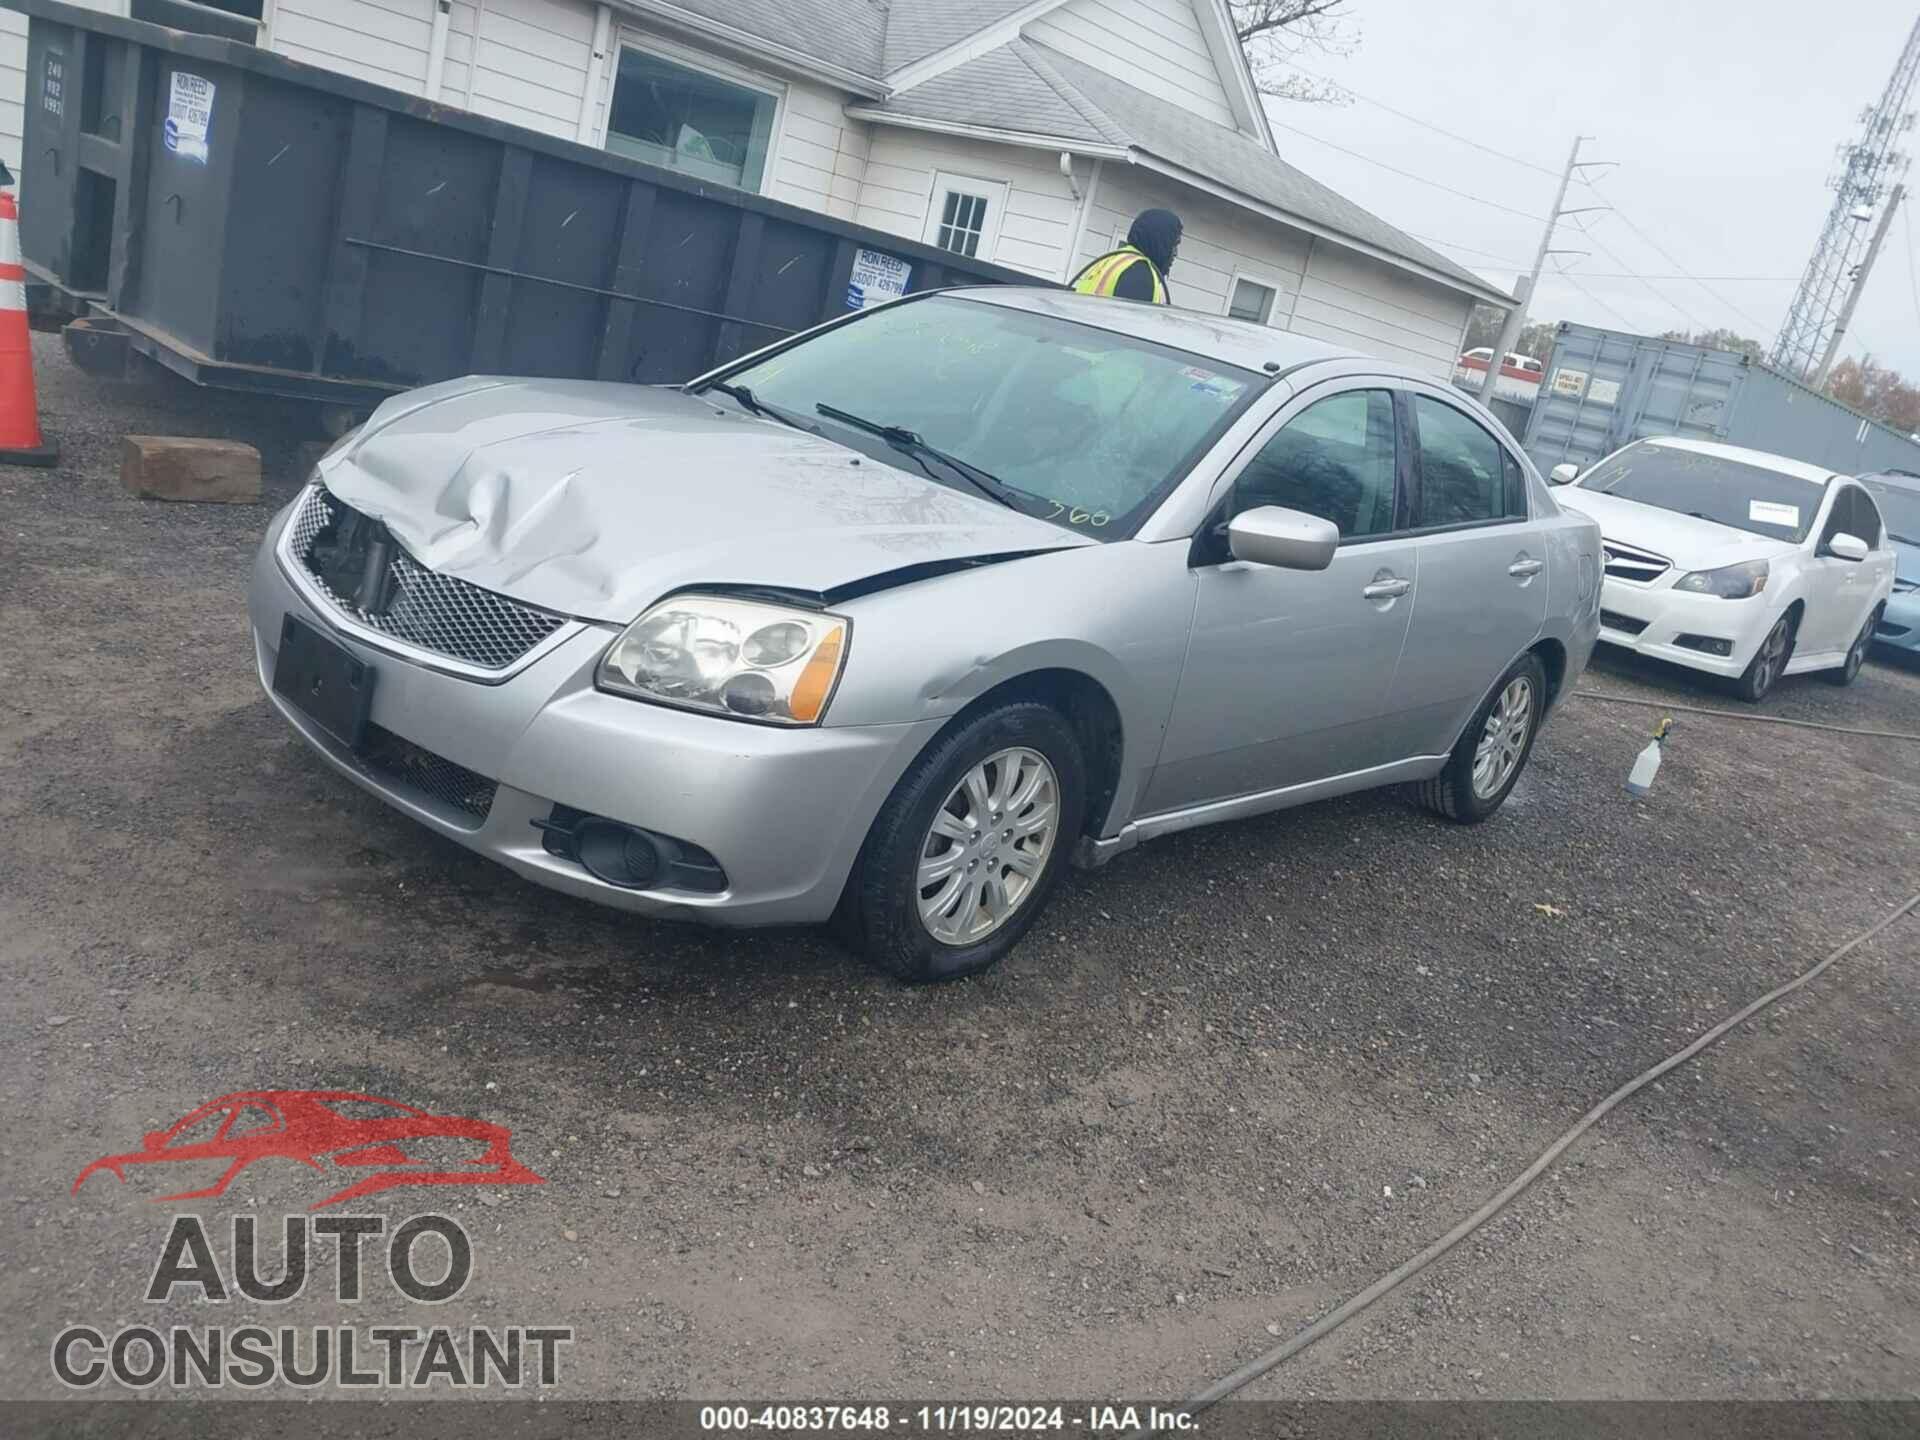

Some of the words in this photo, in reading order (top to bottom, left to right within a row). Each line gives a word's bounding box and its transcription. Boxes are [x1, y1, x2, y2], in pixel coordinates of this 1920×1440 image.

[862, 249, 880, 266] RON
[879, 255, 903, 272] REED
[850, 271, 878, 288] USDOT
